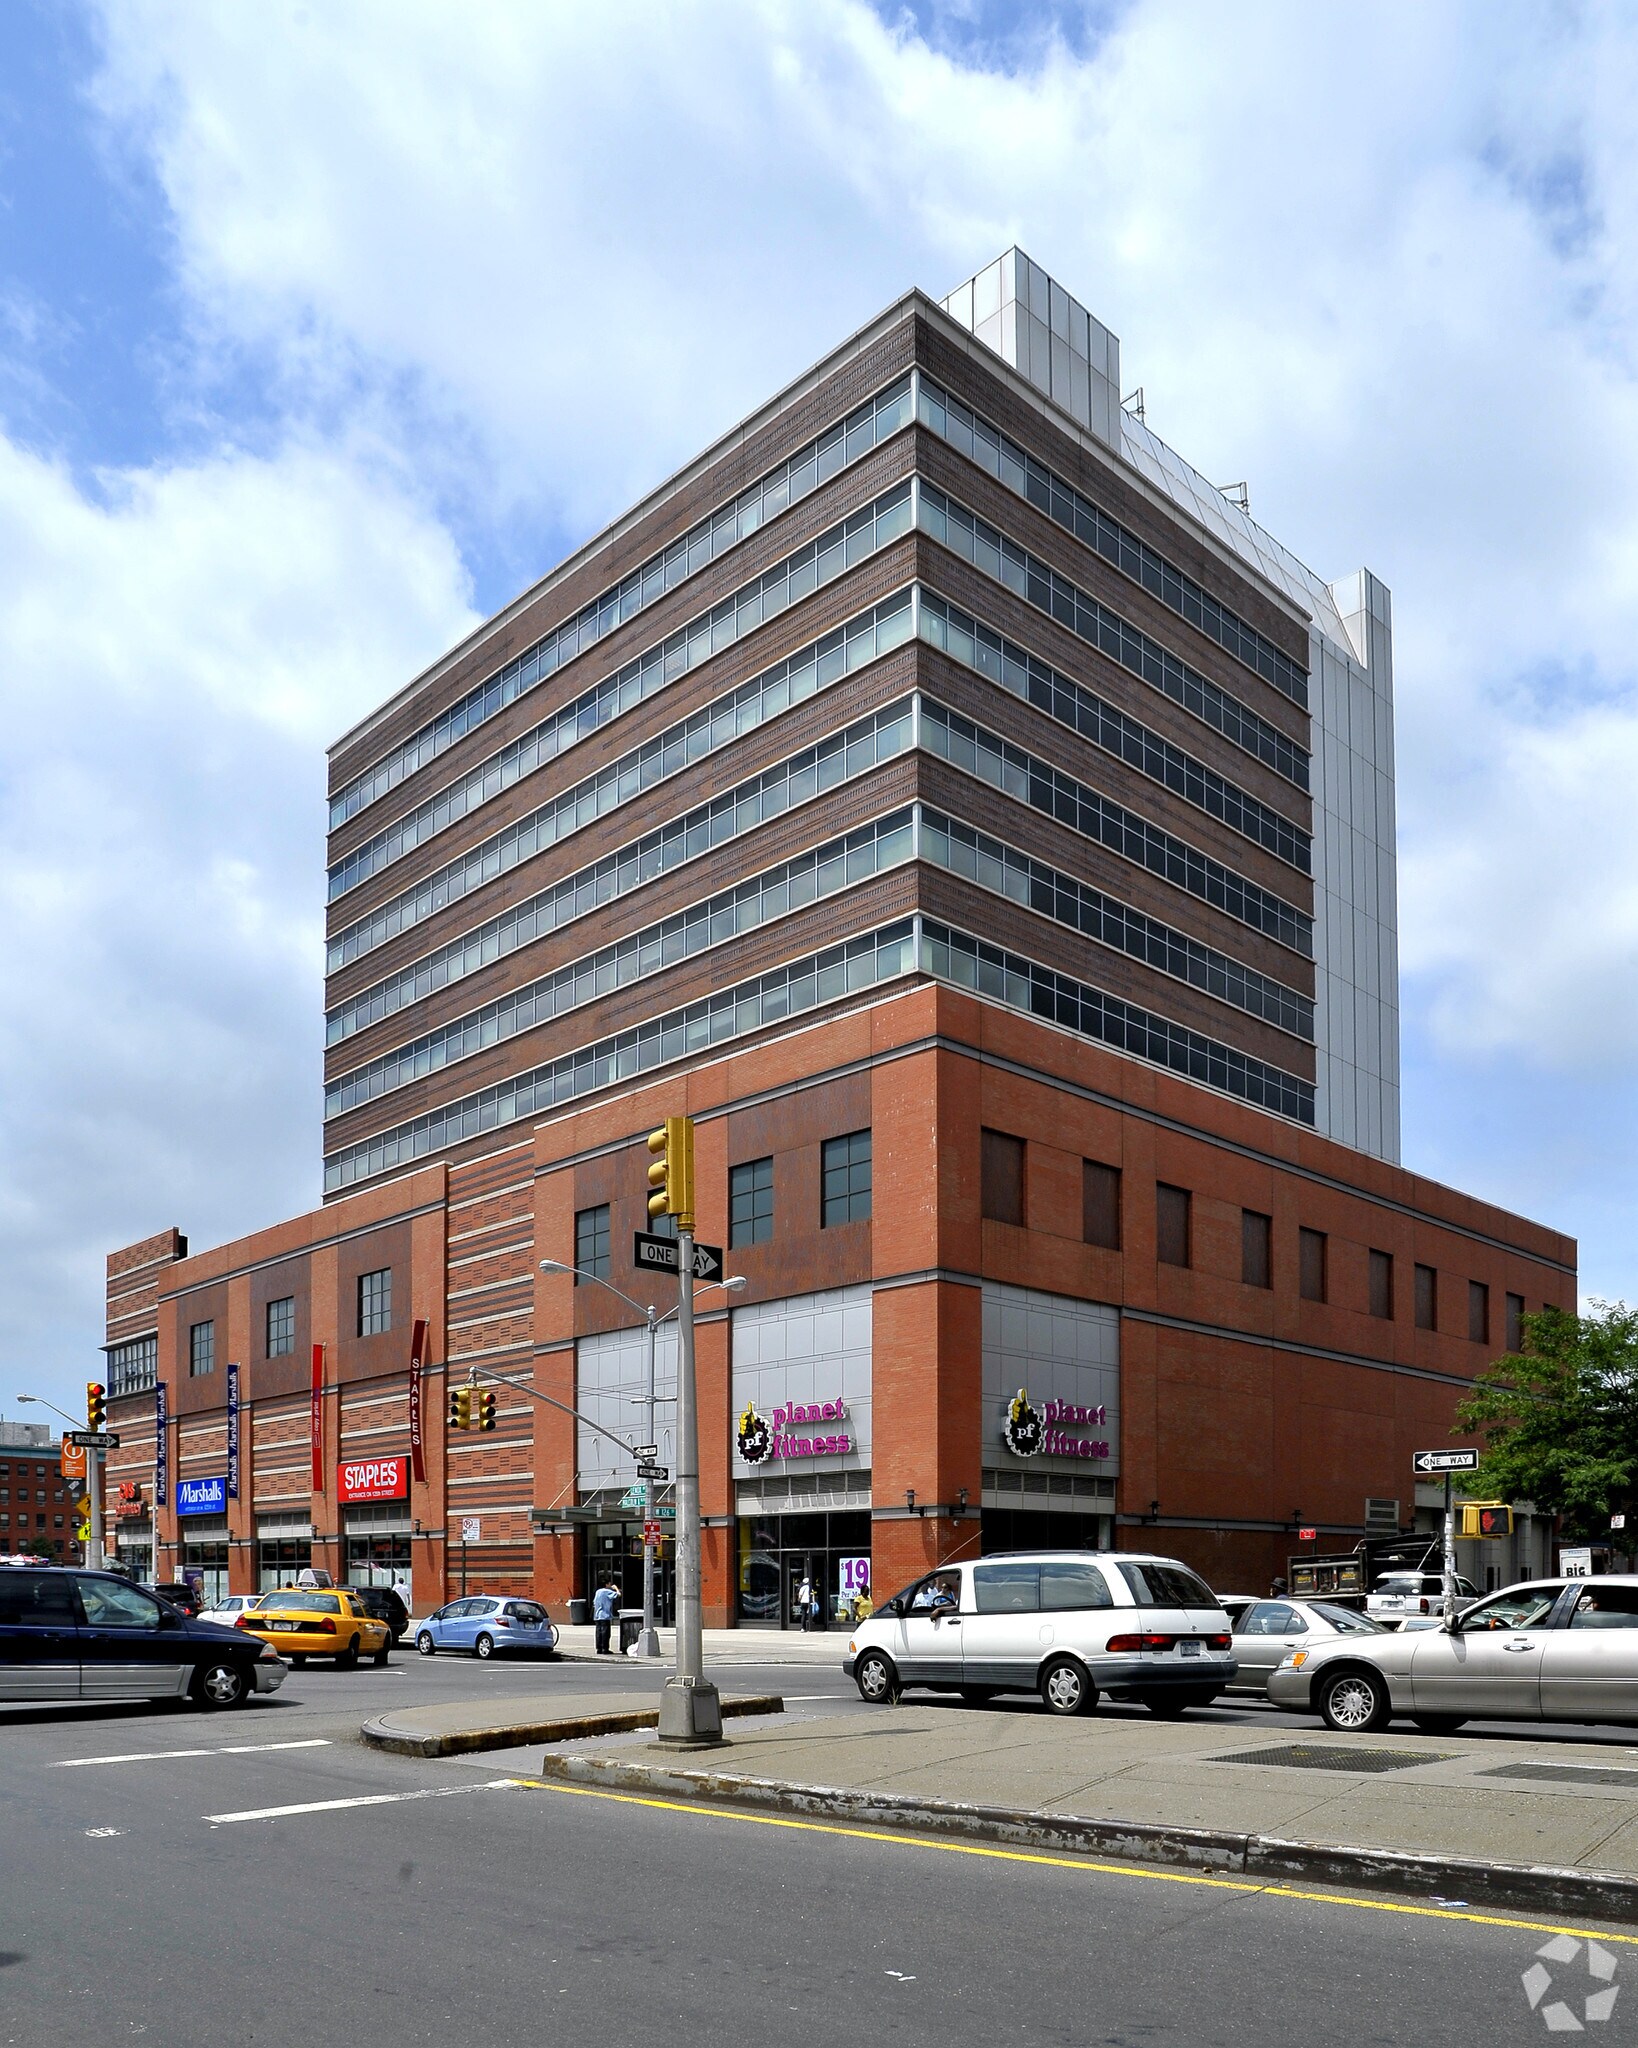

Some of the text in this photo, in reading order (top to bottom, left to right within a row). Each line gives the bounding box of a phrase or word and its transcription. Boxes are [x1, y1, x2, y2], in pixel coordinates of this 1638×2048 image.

[647, 1245, 709, 1270] ONE AY
[411, 1358, 421, 1445] STAPLES
[772, 1396, 844, 1431] planet
[1042, 1398, 1106, 1427] planet
[78, 1436, 92, 1444] ONE
[229, 1371, 237, 1492] Marshalls Marshalls Marshalls
[744, 1431, 764, 1450] pf
[1016, 1423, 1036, 1439] pf
[1042, 1429, 1110, 1458] fitness
[772, 1434, 850, 1459] fitness
[1423, 1455, 1469, 1467] ONE WAY
[344, 1461, 398, 1490] STAPLES
[179, 1480, 222, 1503] Marshalls
